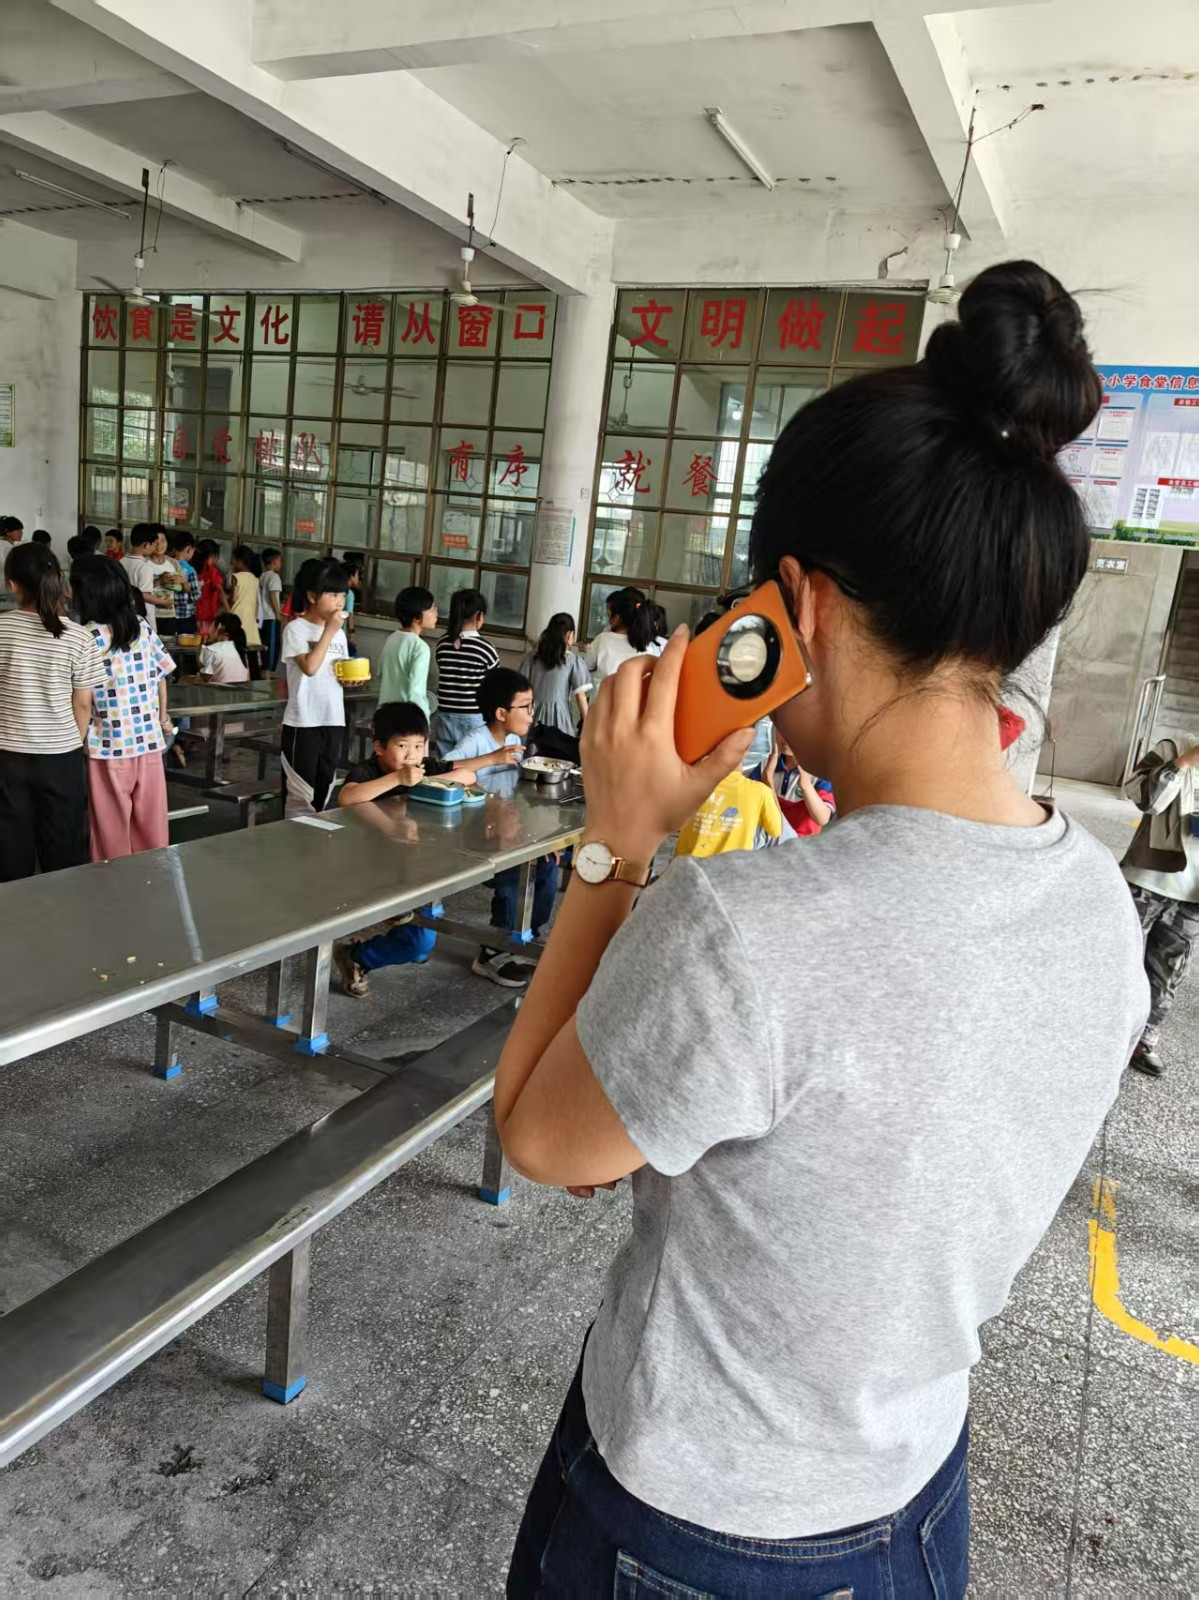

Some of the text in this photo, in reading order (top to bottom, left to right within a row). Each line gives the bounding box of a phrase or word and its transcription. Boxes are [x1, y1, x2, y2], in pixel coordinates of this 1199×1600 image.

[92, 299, 906, 354] 饮食是文化 请从窗口 文明做起
[449, 440, 528, 487] 有序
[614, 450, 719, 496] 就餐
